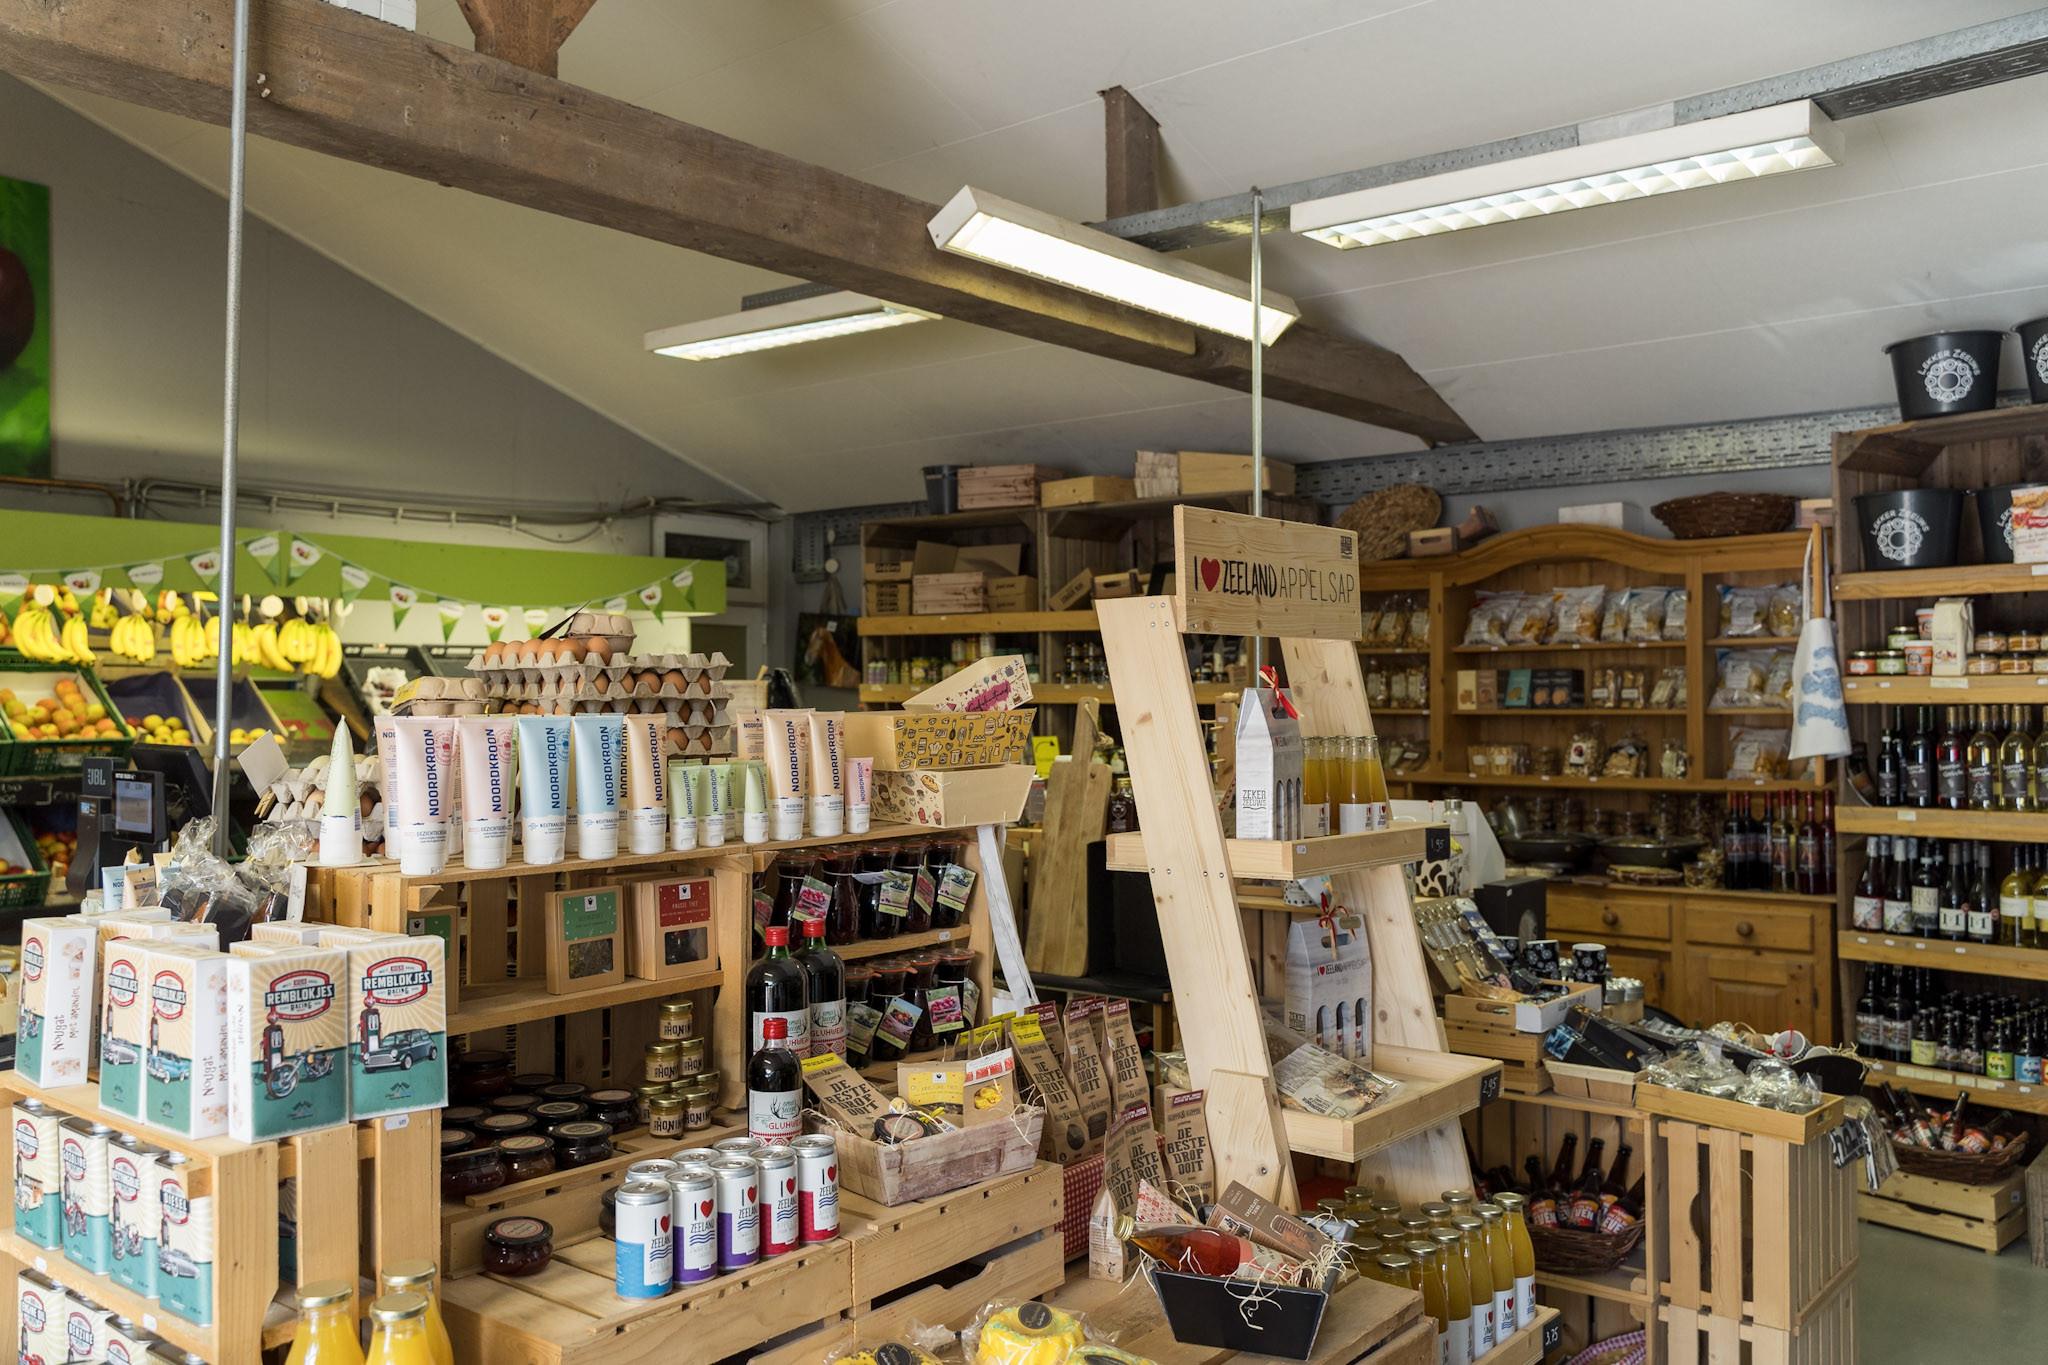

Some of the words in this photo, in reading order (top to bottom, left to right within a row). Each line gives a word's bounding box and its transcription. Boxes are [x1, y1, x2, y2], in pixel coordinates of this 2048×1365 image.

[1193, 555, 1199, 592] I
[1222, 560, 1277, 598] ZEELAND
[1280, 566, 1355, 604] APPELSAP
[648, 723, 663, 801] NOORDKROON
[785, 720, 800, 792] NOORDKROON
[827, 719, 840, 790] NOORDKROON
[423, 729, 440, 816] NOORDKROON
[485, 728, 502, 812] NOORDKROON
[545, 727, 561, 809] NOORDKROON
[599, 726, 615, 806] NOORDKROON
[88, 768, 106, 786] JBL
[1242, 789, 1266, 800] ZEKER
[363, 971, 431, 990] REMBLOKJES
[267, 985, 333, 1006] REMBLOKJES
[824, 1083, 870, 1104] BESTE
[830, 1080, 851, 1094] DE
[837, 1093, 873, 1110] DROP
[847, 1100, 879, 1116] OOIT
[1177, 1127, 1192, 1140] DE
[1132, 1143, 1146, 1158] DE
[1167, 1136, 1206, 1154] BESTE
[1172, 1149, 1204, 1164] DROP
[1177, 1161, 1204, 1176] OOIT
[164, 1193, 188, 1211] DIESEL
